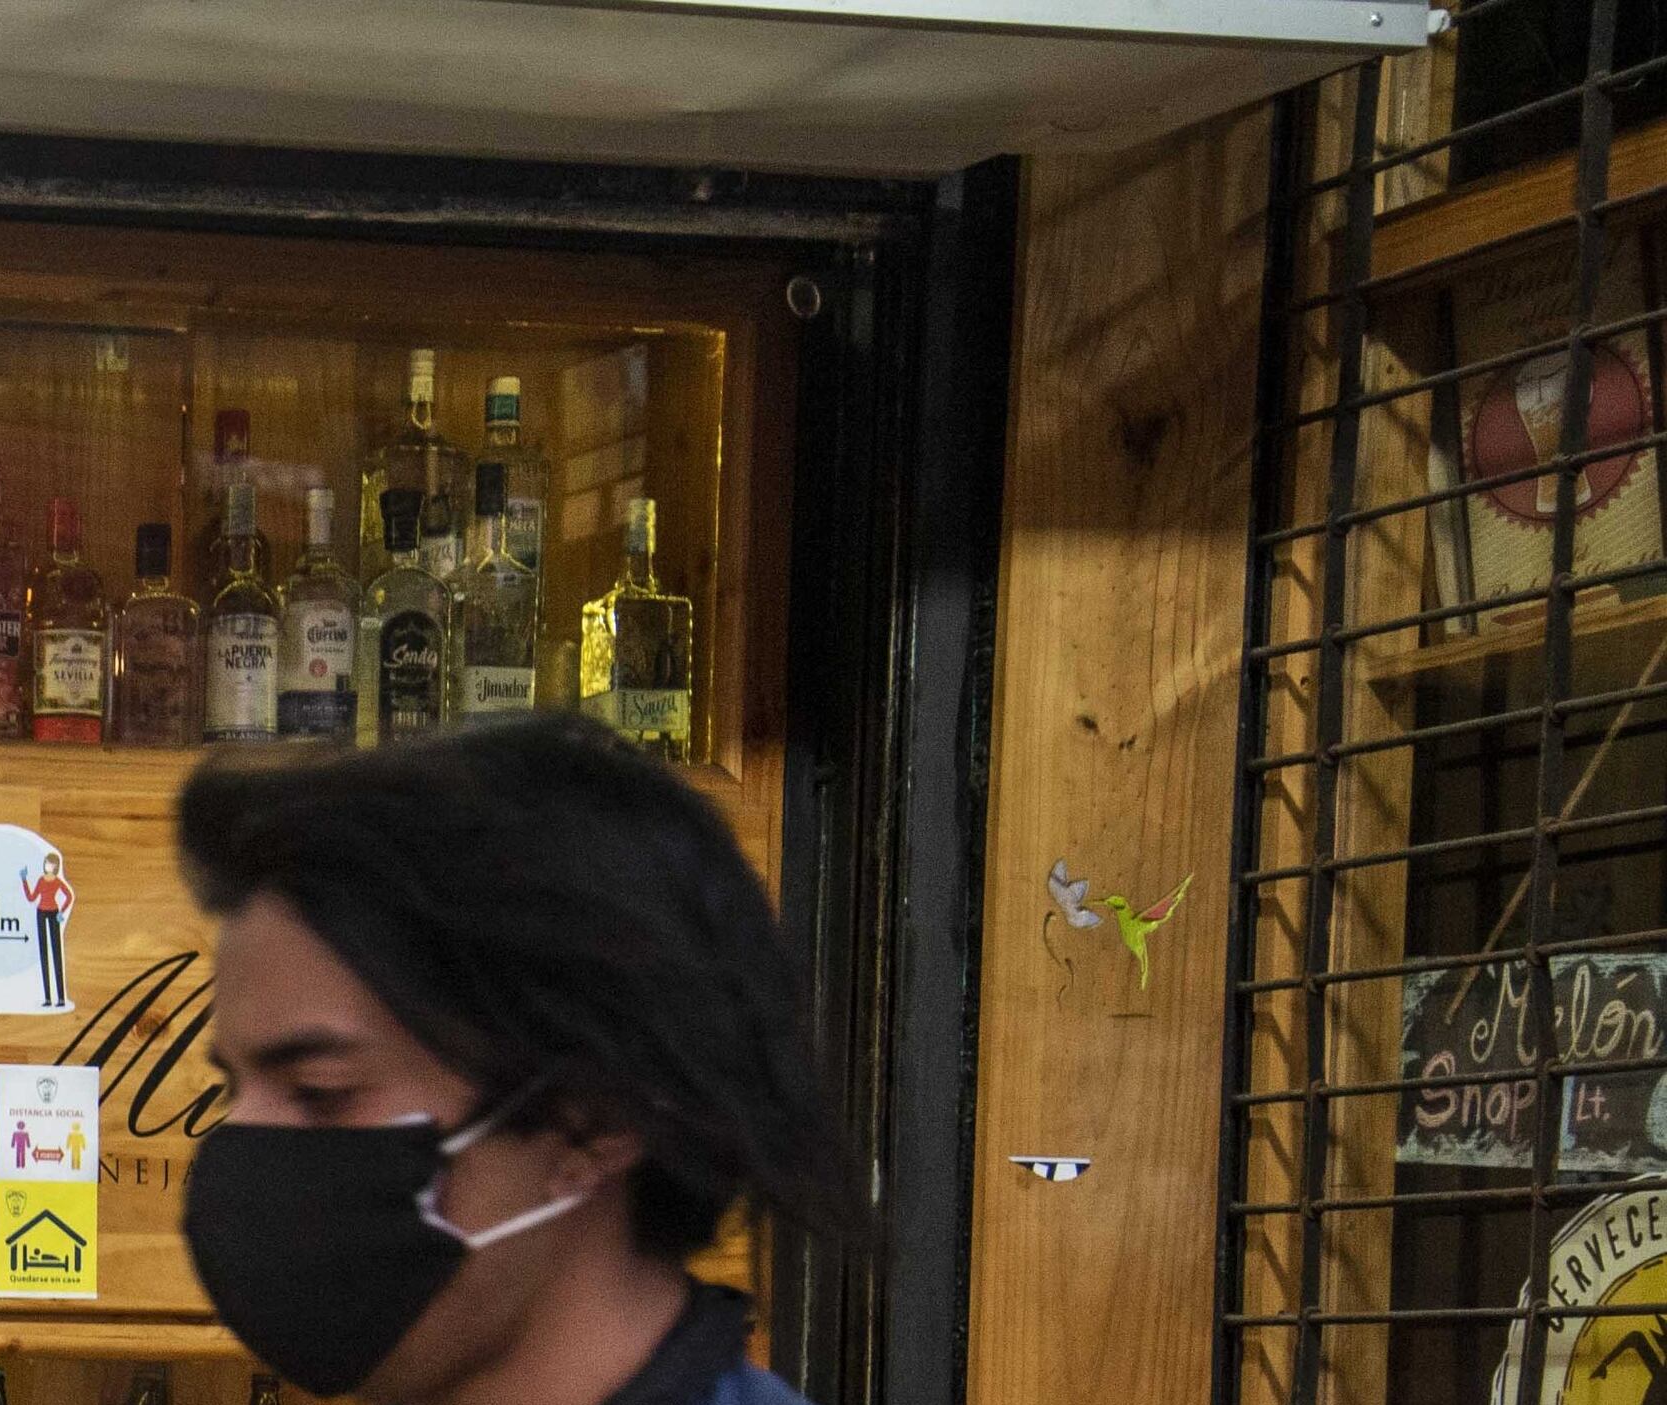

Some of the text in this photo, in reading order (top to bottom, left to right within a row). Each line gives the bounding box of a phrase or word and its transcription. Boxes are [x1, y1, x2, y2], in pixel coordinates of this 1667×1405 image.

[1471, 963, 1665, 1066] Mlón
[9, 1107, 85, 1118] DISTANCIA SOCIAL
